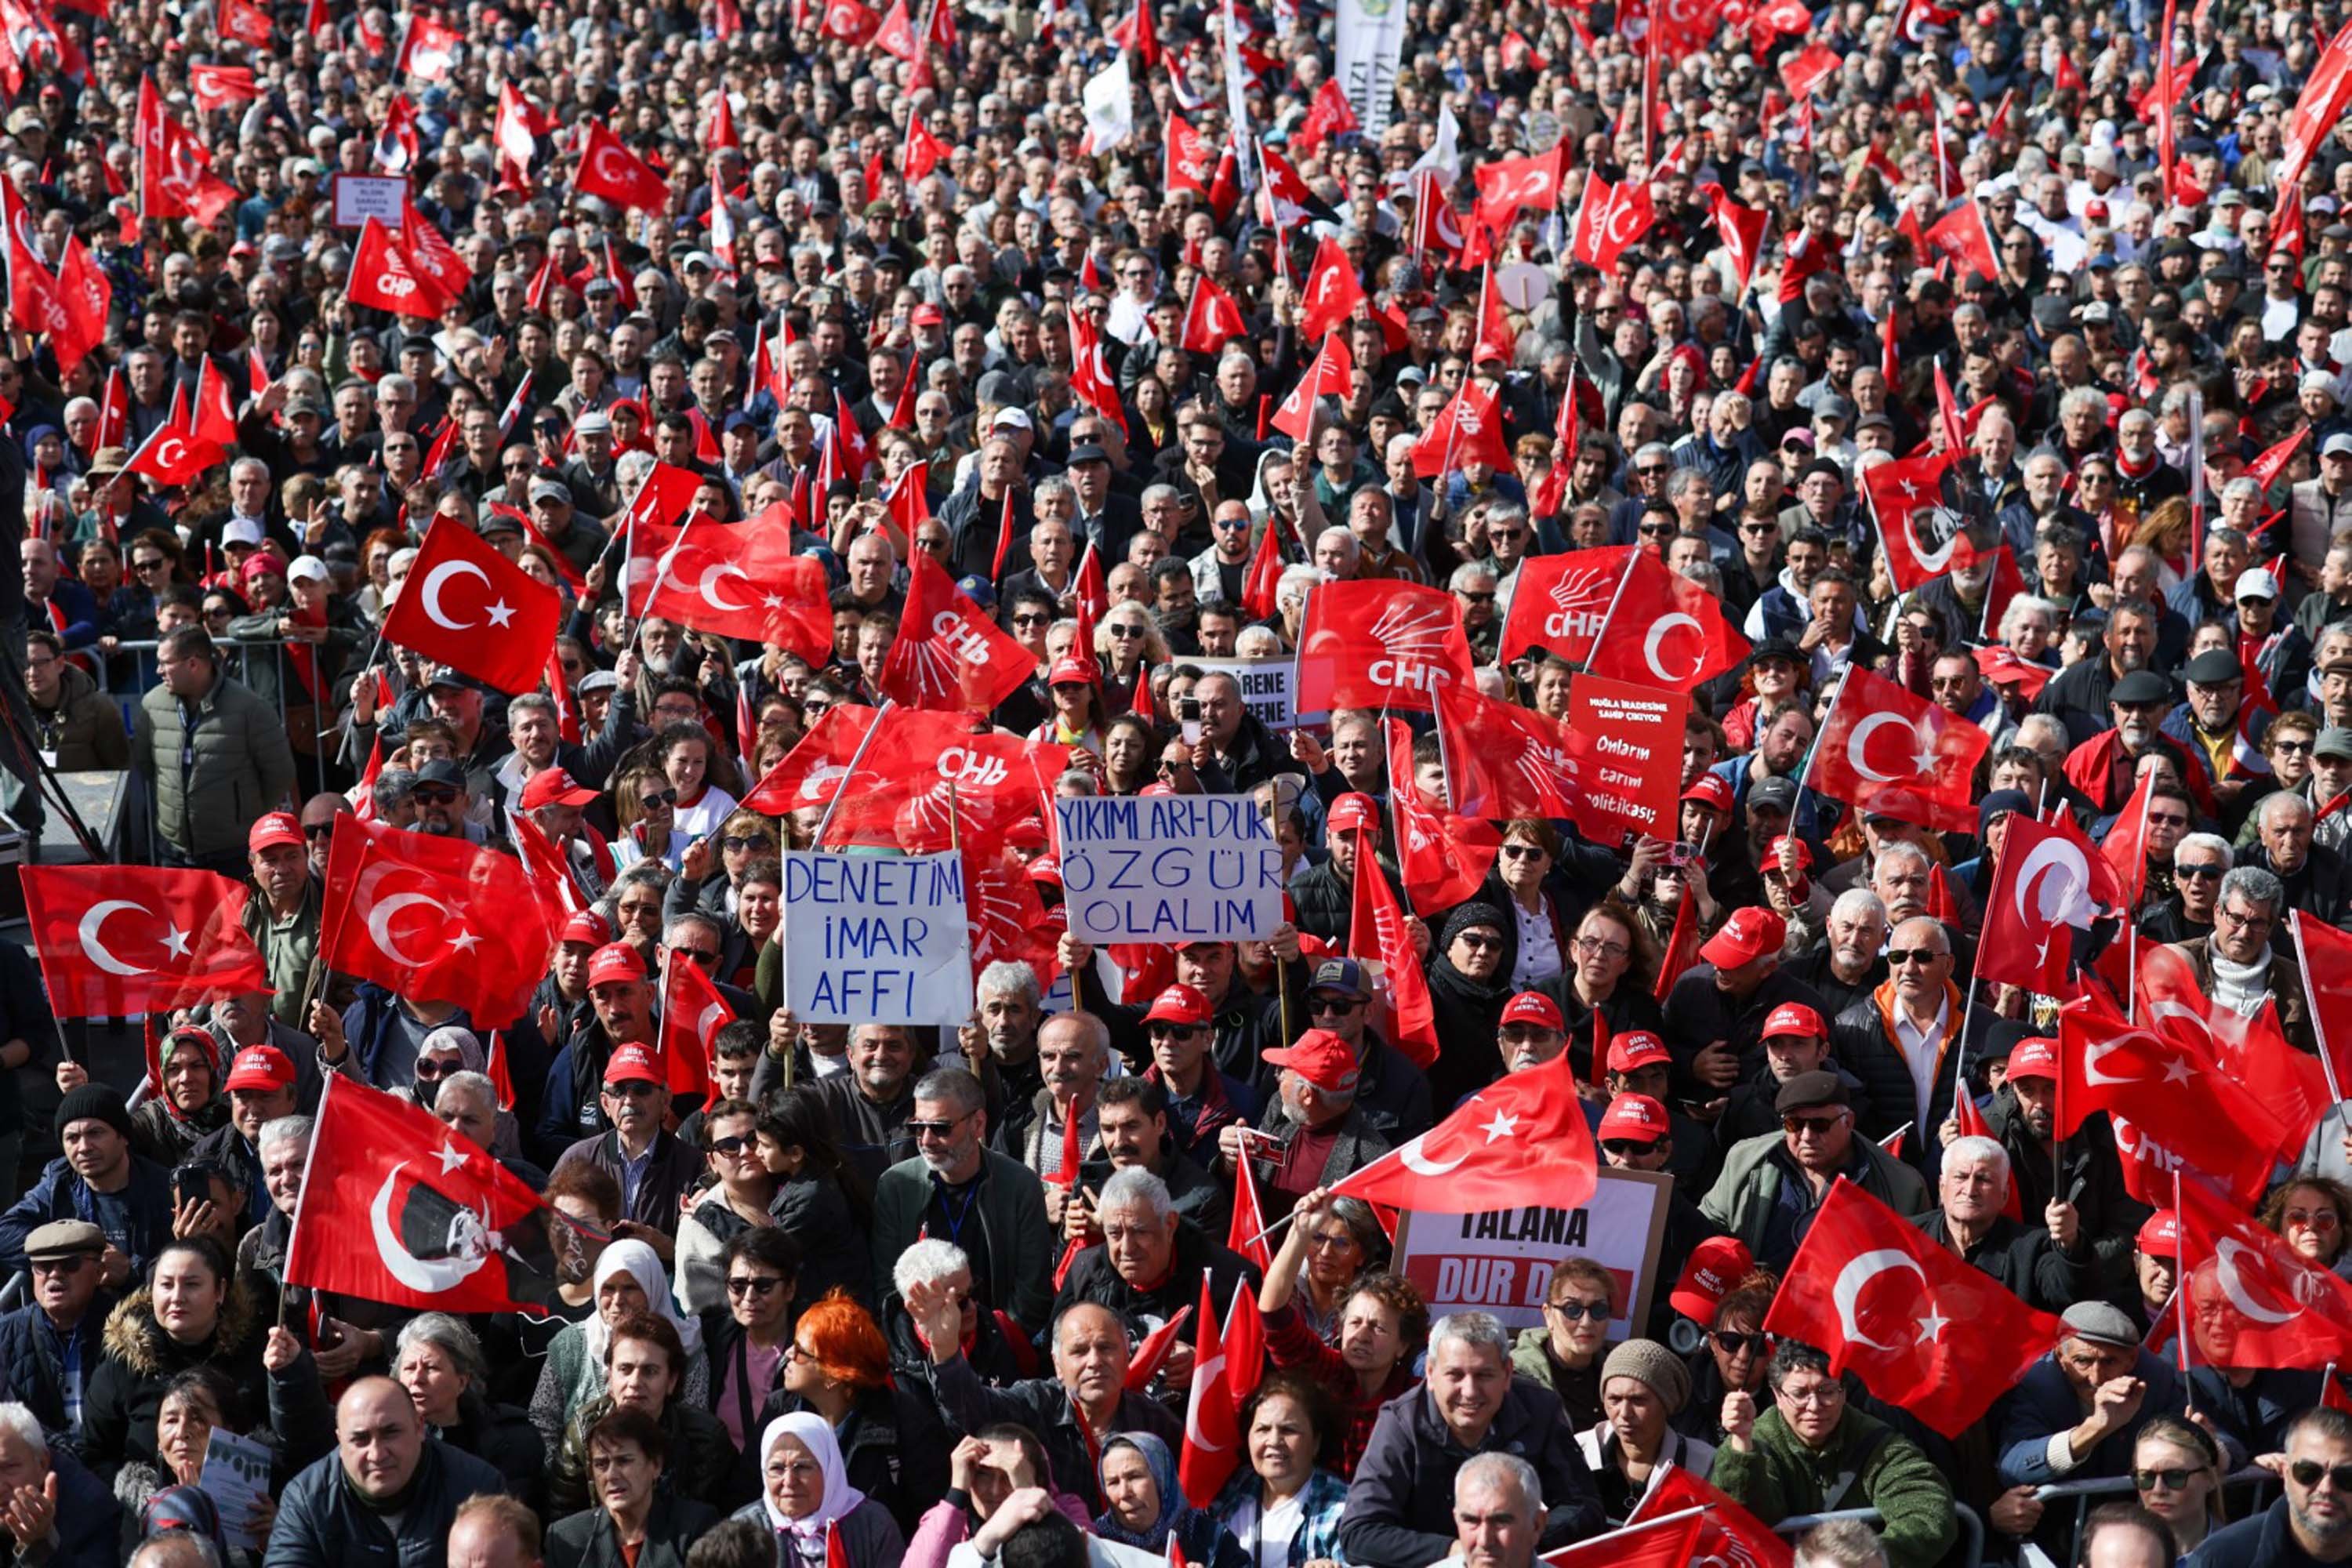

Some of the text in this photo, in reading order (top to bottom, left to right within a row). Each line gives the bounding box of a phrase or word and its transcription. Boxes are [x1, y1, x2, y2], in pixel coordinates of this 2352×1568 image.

[377, 272, 417, 299] CHP
[1595, 735, 1651, 760] Onların
[1599, 767, 1643, 789] tarım
[786, 856, 961, 906] DENETİM
[1062, 846, 1283, 892] ÖZGÜR
[826, 916, 928, 959] İMAR
[1083, 898, 1257, 935] OLALIM
[810, 969, 916, 1018] AFFI
[1435, 1256, 1515, 1304] DUR
